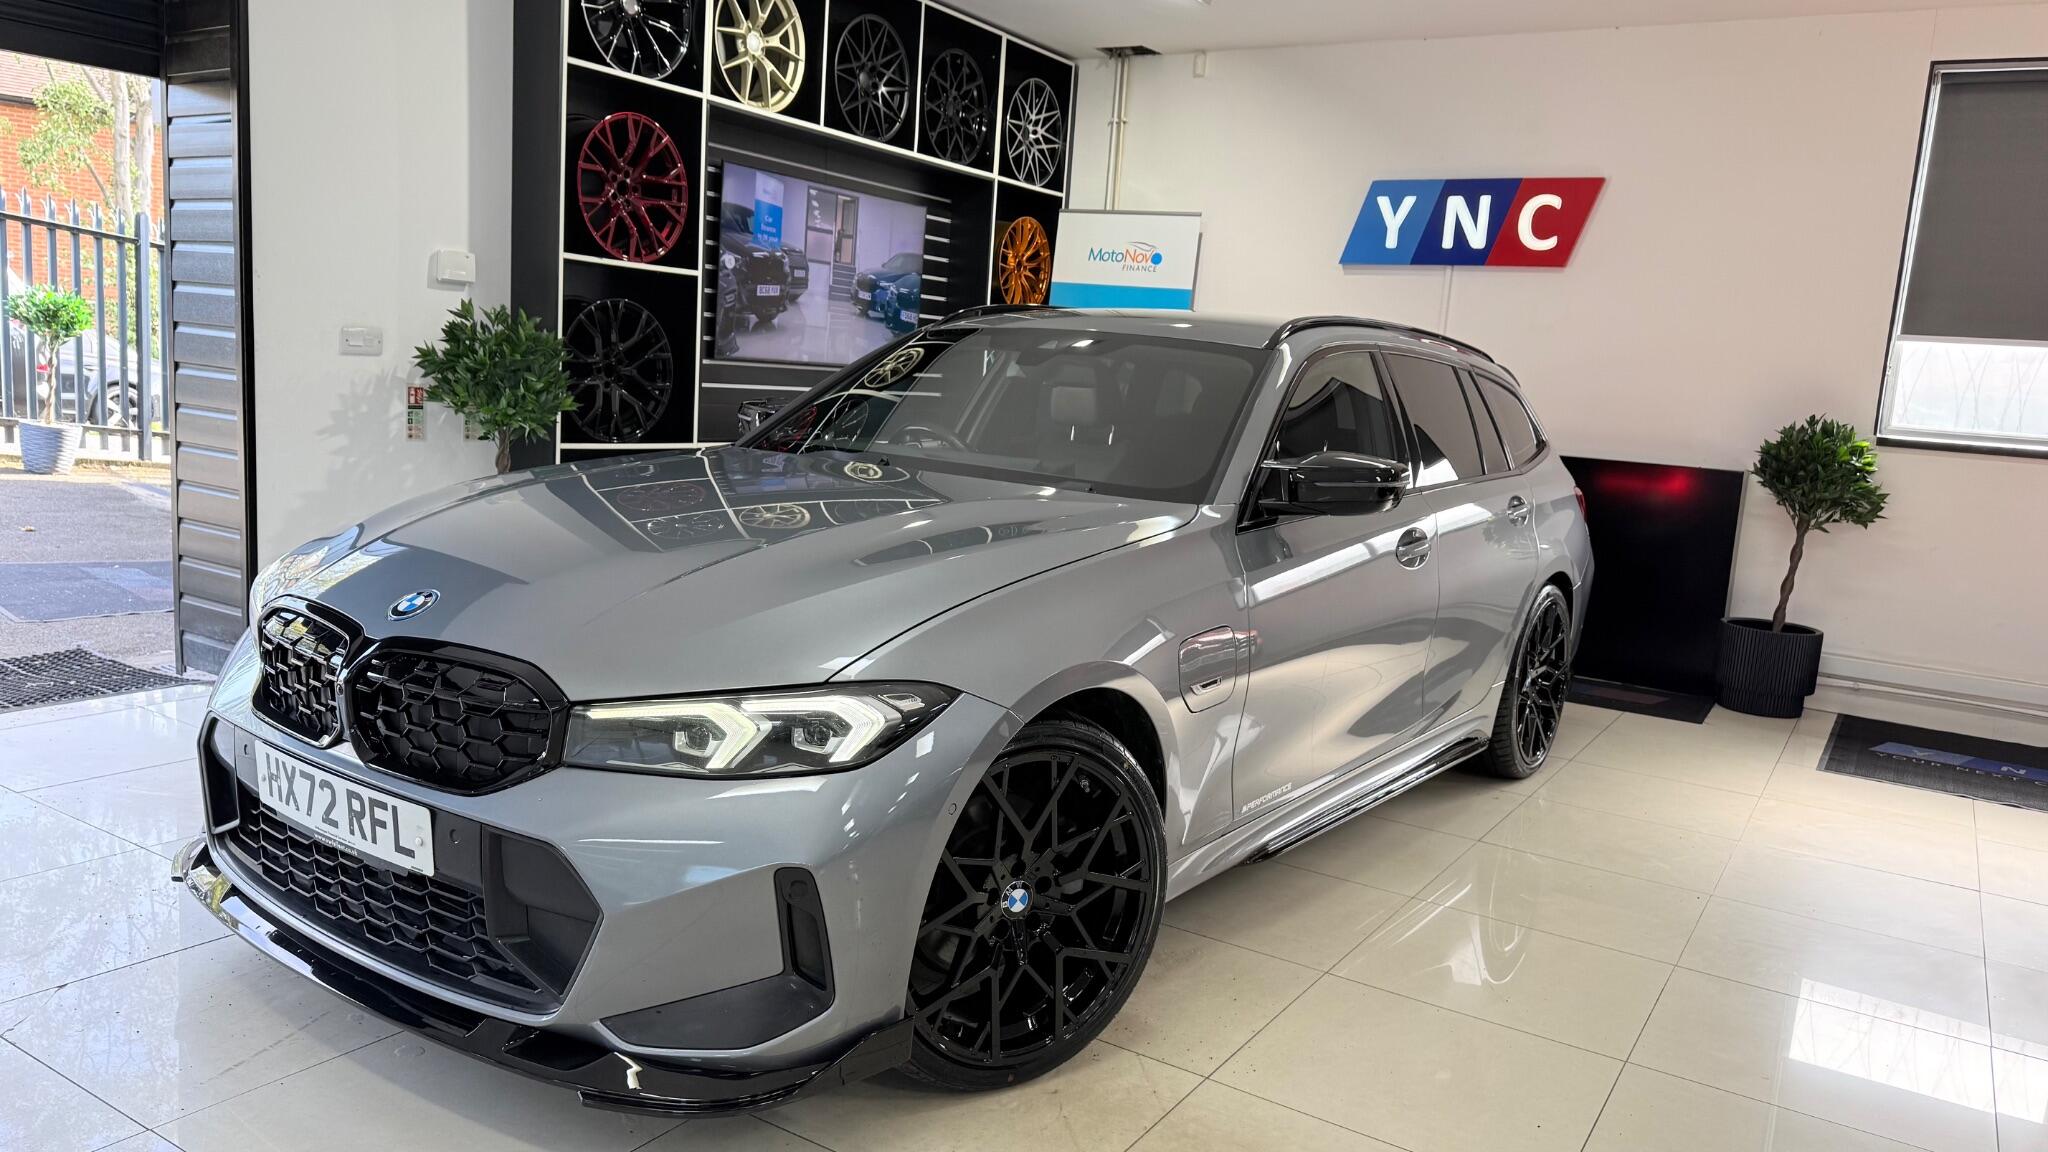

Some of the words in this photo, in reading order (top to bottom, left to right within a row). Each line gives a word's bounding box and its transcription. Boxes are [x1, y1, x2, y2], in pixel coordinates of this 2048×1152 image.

[1376, 193, 1563, 251] YNC
[1122, 264, 1158, 273] FINANCE
[265, 752, 339, 829] HX72
[346, 788, 416, 859] RFL
